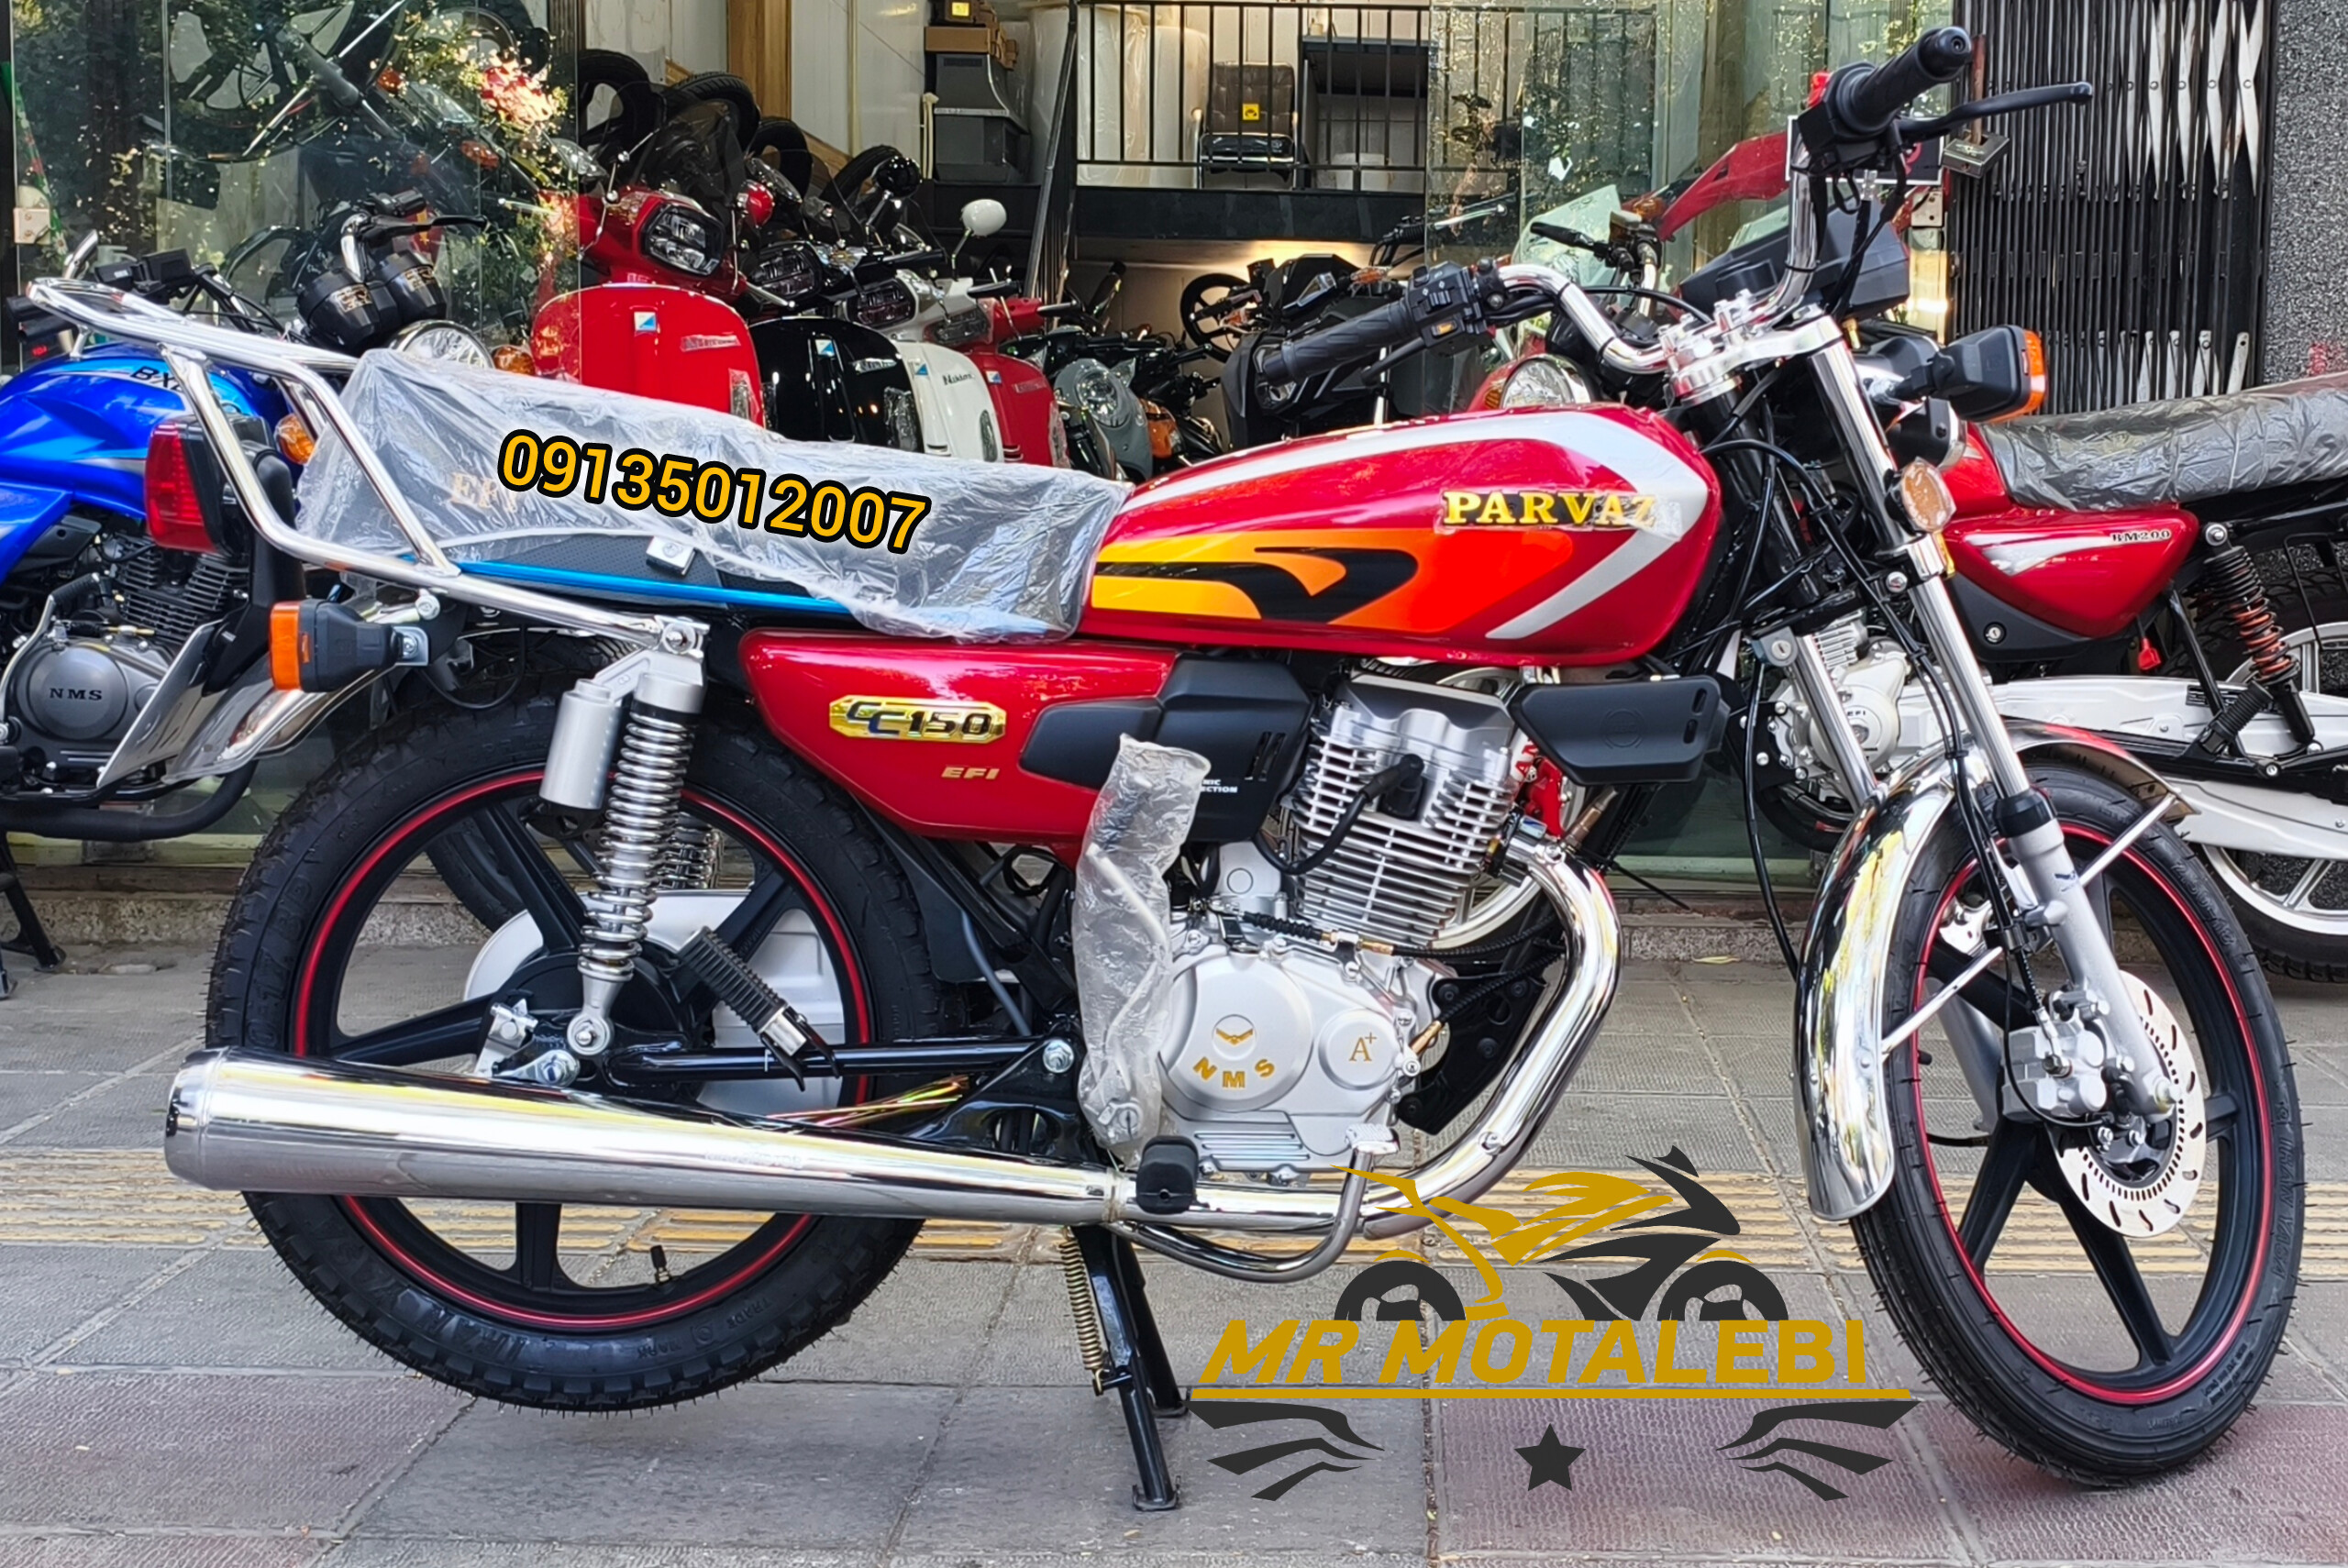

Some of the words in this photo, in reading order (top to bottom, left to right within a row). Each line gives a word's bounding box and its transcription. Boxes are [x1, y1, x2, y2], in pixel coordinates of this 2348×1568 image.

[1443, 491, 1656, 526] PARVAZ
[50, 688, 102, 701] NMS
[941, 765, 1001, 780] EFI
[1192, 1056, 1276, 1088] NMS
